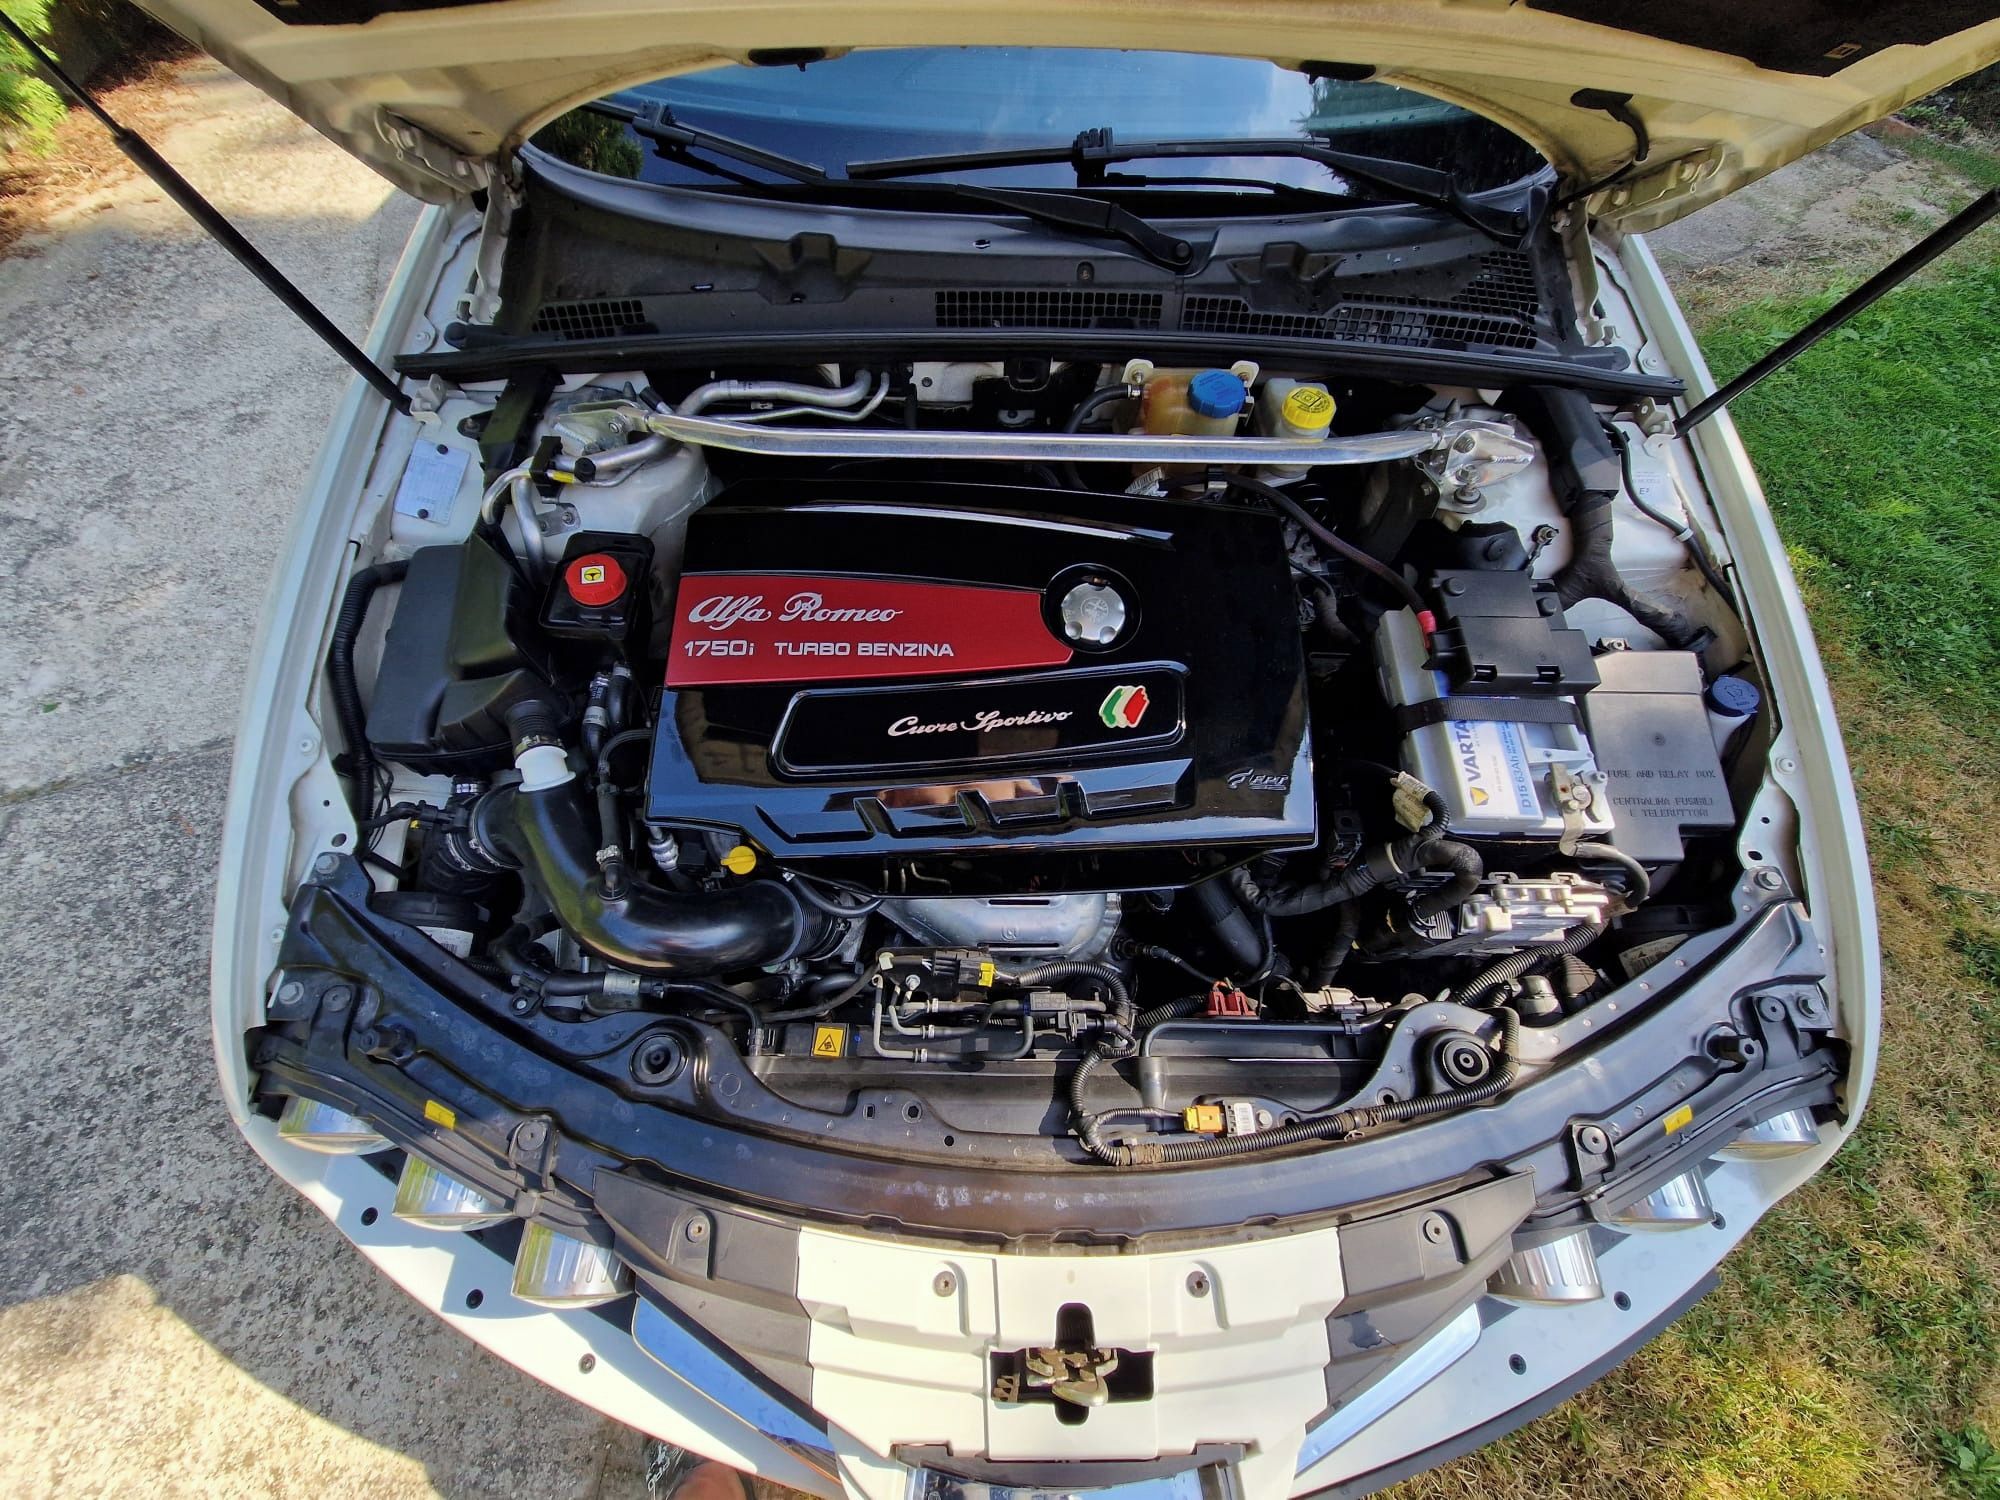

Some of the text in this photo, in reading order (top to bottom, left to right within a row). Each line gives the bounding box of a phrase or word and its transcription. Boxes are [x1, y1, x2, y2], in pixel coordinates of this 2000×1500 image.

[688, 592, 903, 630] Alfa Romeo
[684, 640, 954, 657] 1750i TURBO BENZINA
[888, 709, 1073, 737] Cuore Sportivo
[1454, 719, 1482, 782] VARTA
[1607, 769, 1630, 778] FUSE
[1637, 769, 1654, 778] AND
[1660, 769, 1689, 778] RELAY
[1518, 784, 1532, 808] D15
